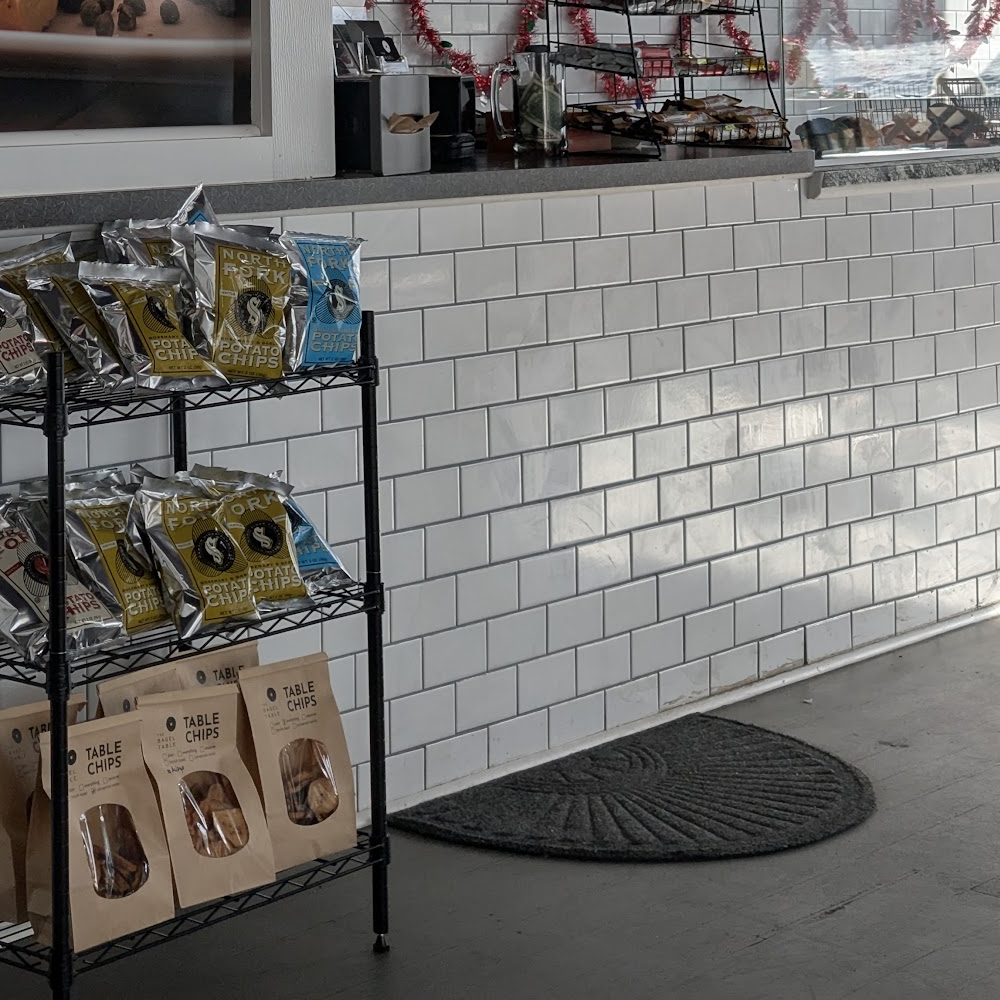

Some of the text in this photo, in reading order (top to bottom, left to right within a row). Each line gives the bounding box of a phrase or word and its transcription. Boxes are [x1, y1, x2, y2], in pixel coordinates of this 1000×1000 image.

[223, 249, 289, 269] NORTH
[223, 262, 286, 285] FORK
[1, 342, 35, 361] CHIPS
[219, 339, 281, 357] POTATO
[217, 351, 280, 369] CHIPS
[65, 592, 94, 603] TATO
[283, 681, 315, 698] TABLE
[287, 695, 317, 712] CHIPS
[183, 712, 220, 729] TABLE
[157, 736, 176, 744] BAGEL
[185, 727, 219, 743] CHIPS
[85, 740, 122, 761] TABLE
[87, 756, 121, 775] CHIPS
